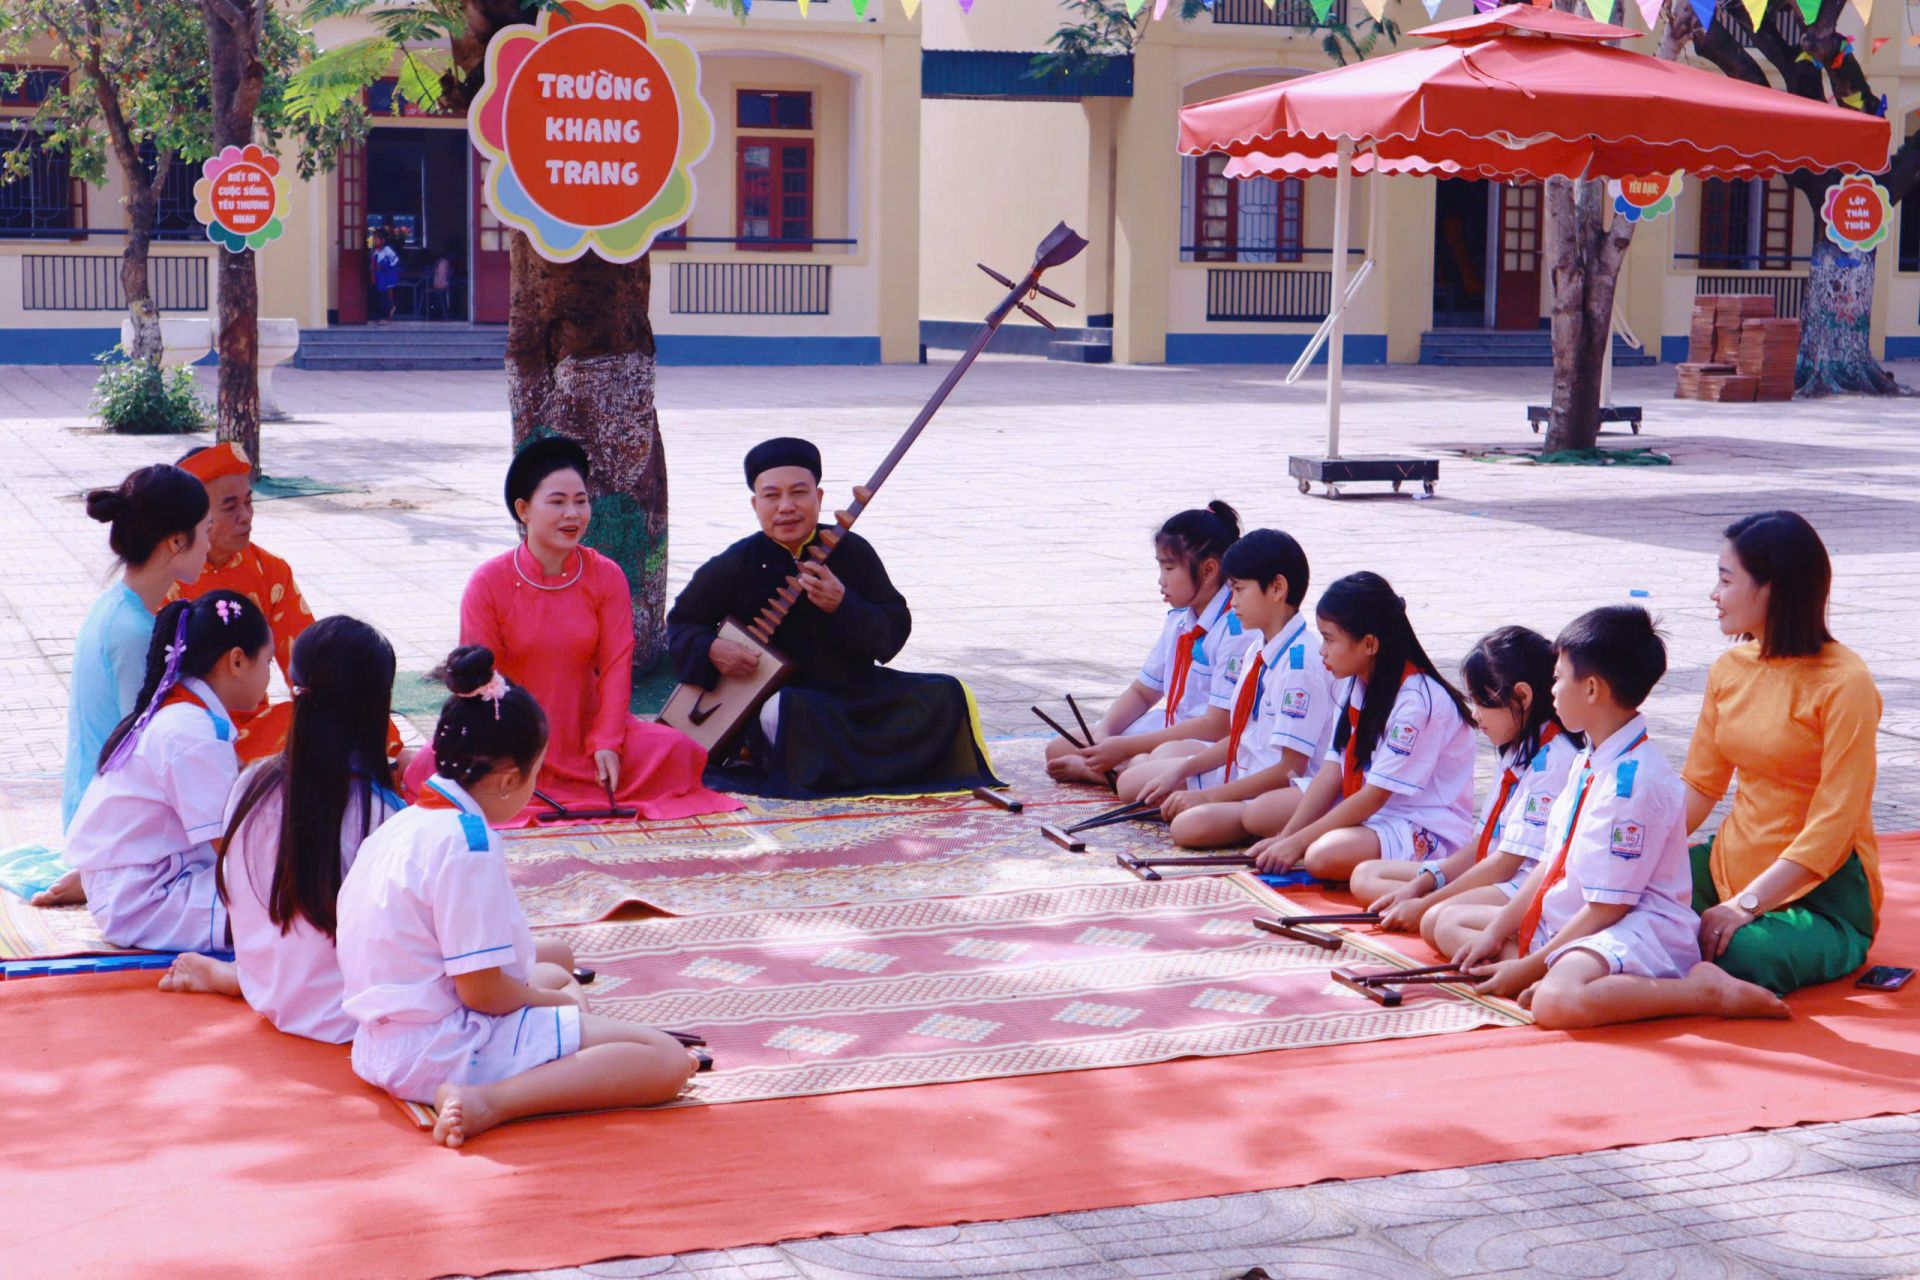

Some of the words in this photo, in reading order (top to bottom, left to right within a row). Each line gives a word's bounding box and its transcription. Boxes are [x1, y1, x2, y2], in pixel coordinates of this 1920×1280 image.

[537, 69, 650, 102] TRƯỜNG
[545, 117, 641, 144] KHANG
[545, 160, 639, 186] TRANG
[218, 185, 241, 198] CUỘC
[218, 200, 234, 210] YÊU
[1849, 196, 1866, 206] LỚP
[233, 215, 255, 224] NHAU
[1845, 220, 1870, 232] THIỆN
